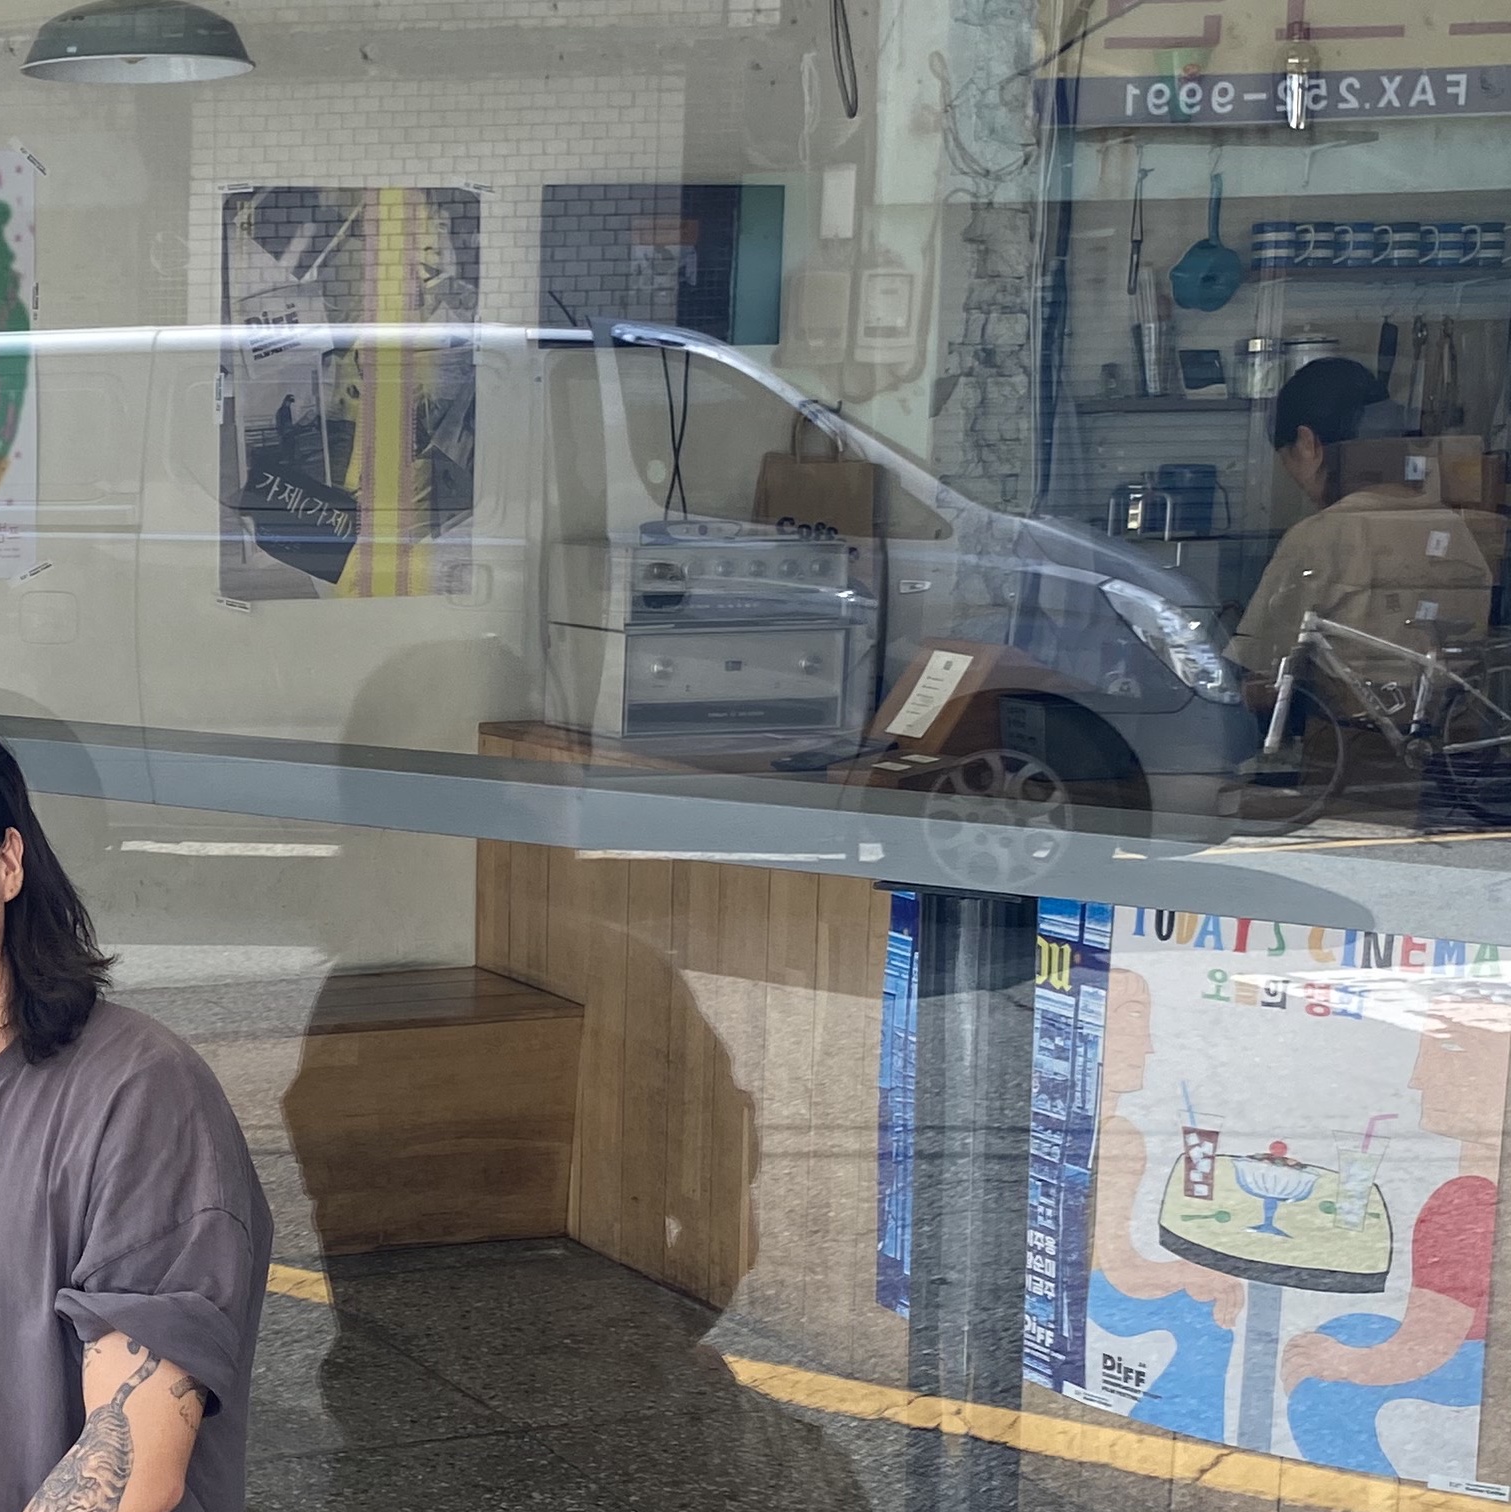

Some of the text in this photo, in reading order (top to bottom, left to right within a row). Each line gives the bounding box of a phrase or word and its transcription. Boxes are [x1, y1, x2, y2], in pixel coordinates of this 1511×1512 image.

[256, 472, 352, 540] 가제(가제)
[1308, 924, 1502, 978] CINEMA
[1102, 1352, 1146, 1387] DiFF
